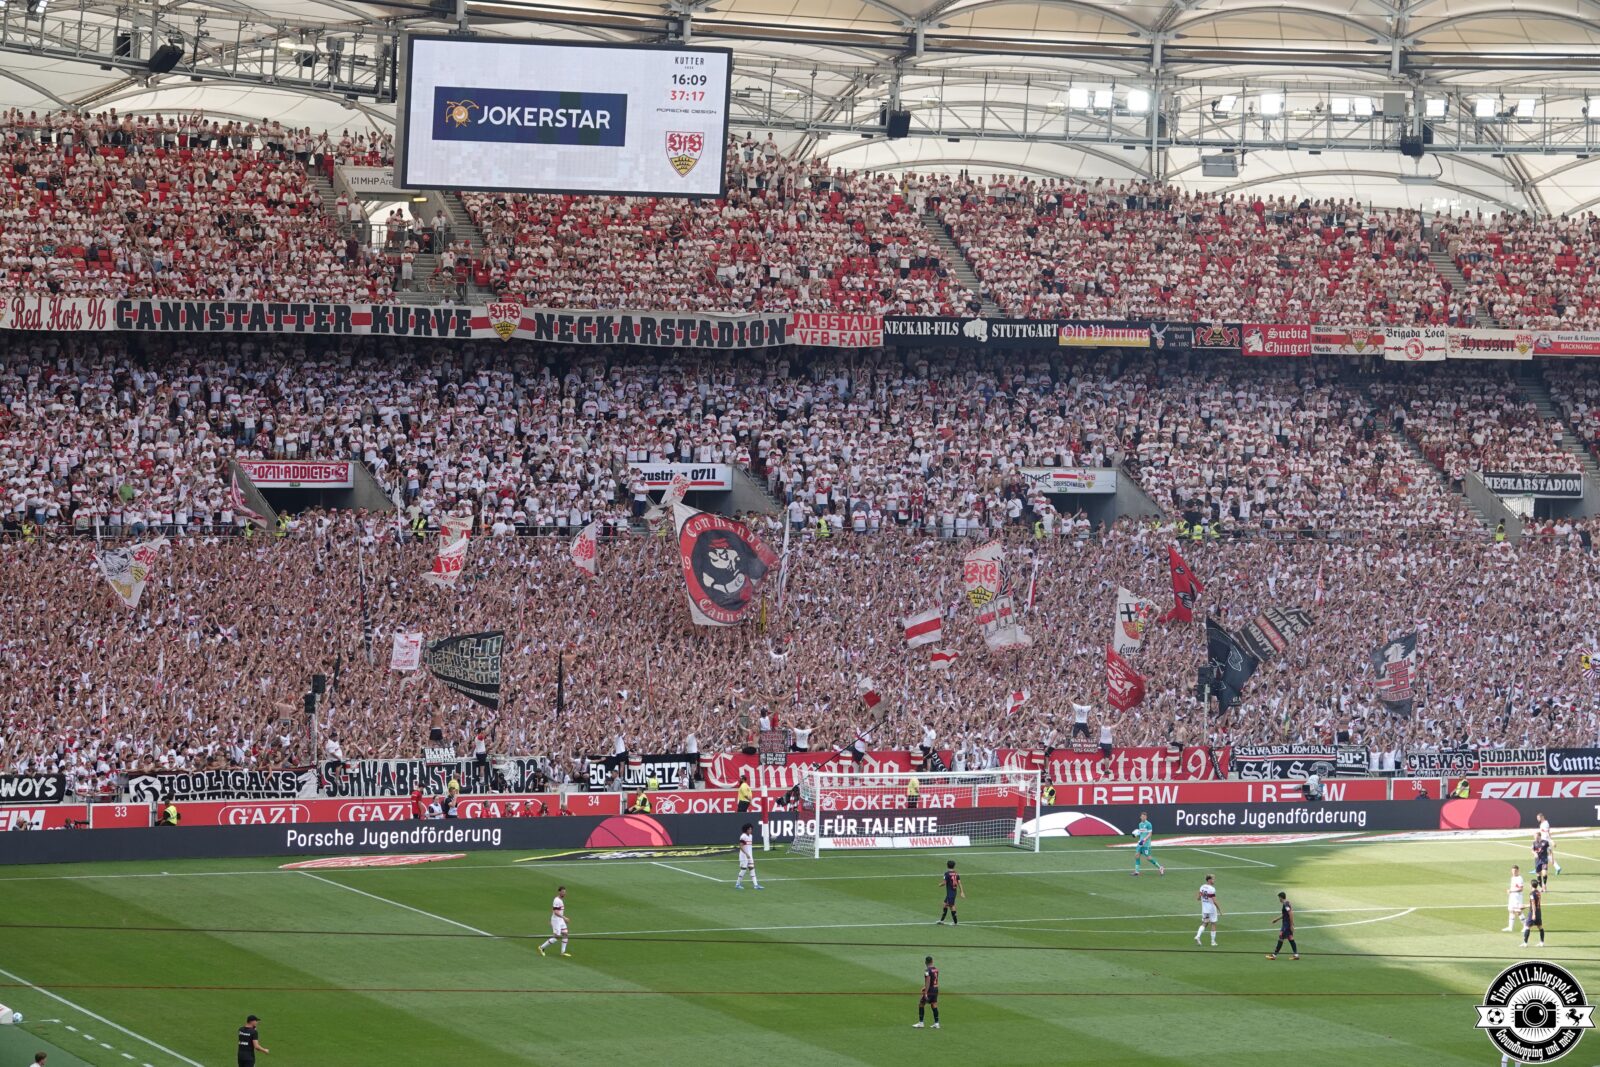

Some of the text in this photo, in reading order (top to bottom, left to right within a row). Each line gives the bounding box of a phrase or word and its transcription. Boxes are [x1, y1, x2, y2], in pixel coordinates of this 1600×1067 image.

[675, 57, 705, 65] KUTTER
[672, 74, 707, 86] 16:09
[670, 90, 705, 101] 37:17
[477, 106, 611, 129] JOKERSTAR
[10, 295, 107, 330] Red Hots 96
[115, 300, 472, 338] CANNSTATTER KURVE
[798, 314, 883, 330] ALBSTADT
[534, 312, 787, 348] NECKARSTADION
[884, 320, 1059, 339] NECKAR-FILS STUTTGART
[1062, 323, 1150, 342] Old Warriors
[1267, 328, 1308, 340] Suebia
[1385, 328, 1445, 339] Brigada Loca
[799, 330, 881, 347] VFB-FANS
[257, 465, 281, 479] 0711
[283, 465, 331, 479] ADDICTS
[691, 468, 716, 480] 0711
[1484, 477, 1581, 491] NECKARSTADION
[1234, 744, 1337, 755] SCHWABEN KOMPANIE
[1336, 751, 1368, 764] 50+1
[1408, 753, 1474, 769] CREW 36
[1003, 749, 1179, 784] Cnnstatt
[1481, 765, 1546, 777] STUTTGART
[158, 771, 297, 793] HOOLIGANS
[1411, 780, 1422, 791] 36
[997, 787, 1009, 798] 35
[588, 795, 600, 807] 34
[843, 793, 956, 810] JOKERTAR
[114, 806, 127, 818] 33
[1176, 808, 1367, 829] Porsche Jugendförderung
[824, 815, 858, 836] FÜR
[862, 817, 937, 835] TALENTE
[287, 825, 501, 848] Porsche Jugendförderung
[832, 836, 955, 847] WINAMAX WINAMAX
